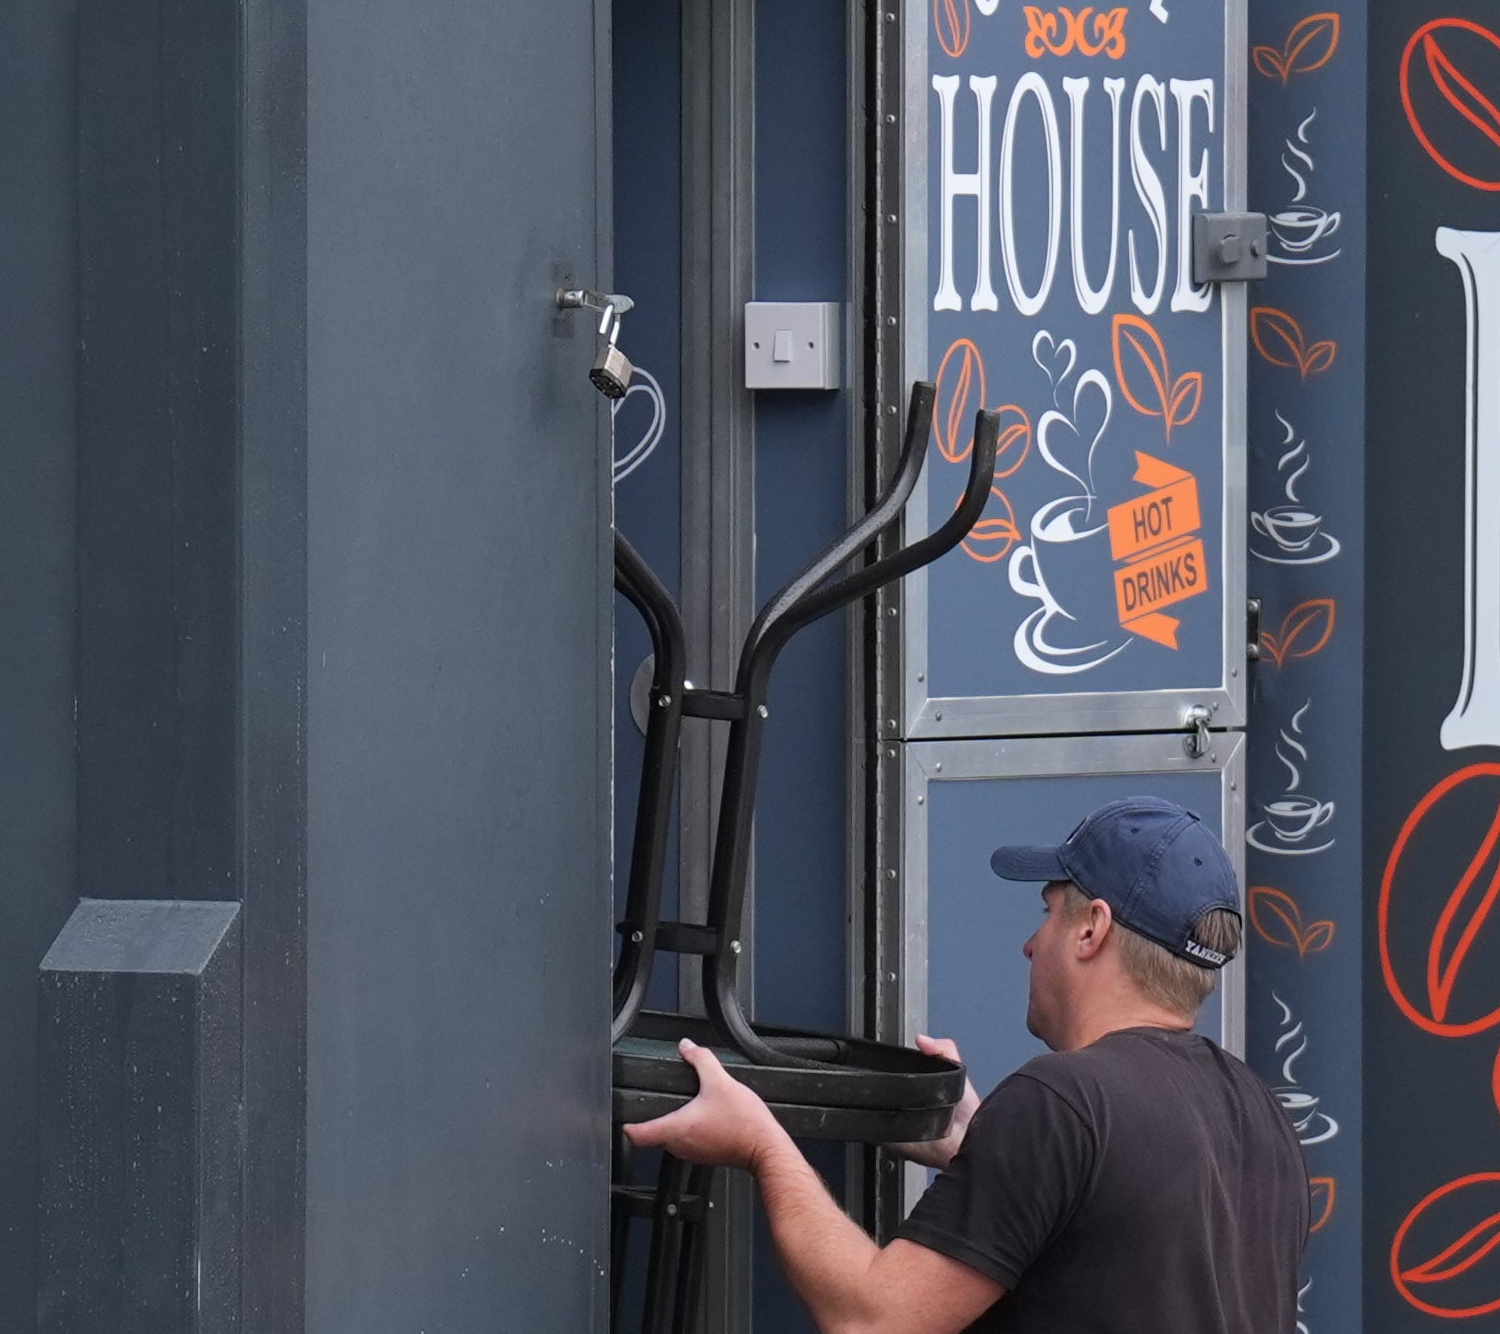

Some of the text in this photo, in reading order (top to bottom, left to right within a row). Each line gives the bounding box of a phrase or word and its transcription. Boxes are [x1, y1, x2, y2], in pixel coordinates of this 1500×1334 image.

[931, 70, 1216, 317] HOUSE
[1132, 496, 1173, 544] HOT
[1122, 552, 1198, 612] DRINKS
